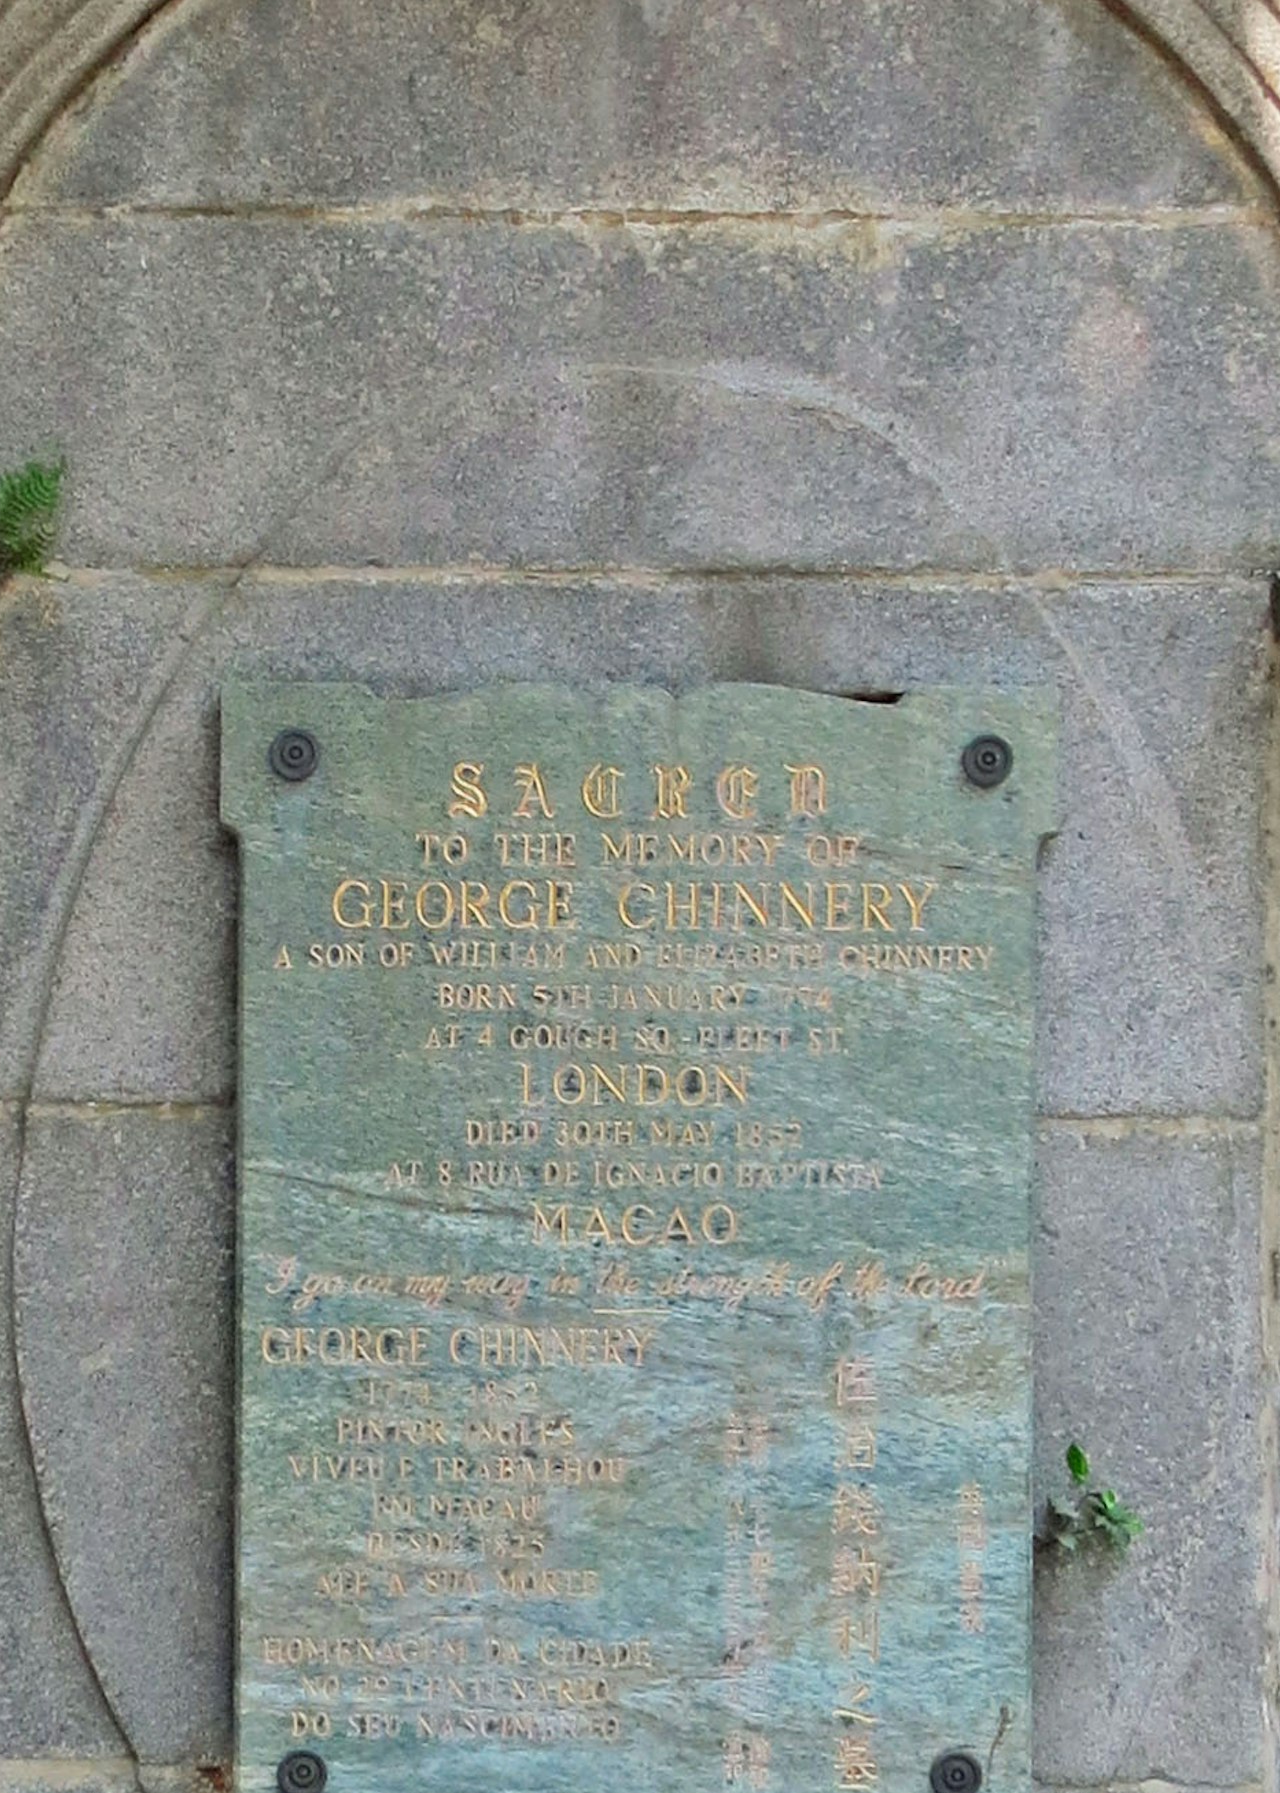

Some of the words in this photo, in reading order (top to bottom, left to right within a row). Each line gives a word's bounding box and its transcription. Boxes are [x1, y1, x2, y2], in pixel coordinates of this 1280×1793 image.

[447, 761, 828, 820] SACRED
[415, 833, 468, 867] TO
[493, 833, 577, 867] THE
[600, 833, 784, 868] MEMORY
[806, 834, 861, 868] OF
[331, 879, 575, 931] GEORGE
[618, 880, 939, 933] CHINNERY
[273, 945, 294, 970] A
[307, 943, 366, 969] SON
[378, 943, 416, 969] OF
[428, 941, 567, 969] WILLIAM
[584, 943, 644, 970] AND
[657, 943, 827, 970] ELIZABETH
[838, 943, 995, 971] CHINNERY
[437, 983, 516, 1010] BORN
[532, 983, 592, 1010] 5TH
[608, 983, 748, 1012] JANUARY
[423, 1024, 463, 1050] AT
[477, 1024, 496, 1050] 4
[509, 1024, 620, 1051] GOUGH
[519, 1062, 751, 1107] LONDON
[465, 1119, 541, 1148] DIED
[554, 1120, 635, 1148] 30TH
[650, 1120, 717, 1148] MAY
[386, 1160, 424, 1188] AT
[437, 1161, 454, 1188] 8
[468, 1160, 524, 1188] RUA
[544, 1160, 581, 1188] DE
[593, 1160, 725, 1188] IGNACIO
[735, 1161, 884, 1191] BAPTISTA
[530, 1201, 740, 1246] MACAO
[293, 1273, 346, 1310] go
[352, 1273, 394, 1294] on
[404, 1273, 452, 1306] my
[462, 1273, 531, 1308] way
[549, 1268, 582, 1295] in
[599, 1261, 639, 1295] the
[797, 1260, 844, 1312] of
[261, 1327, 433, 1366] GEORGE
[448, 1325, 657, 1368] CHINNERY
[336, 1418, 449, 1446] PINTOR
[288, 1455, 386, 1483] VIVEU
[399, 1455, 416, 1483] E
[433, 1456, 629, 1485] TRABALHOU
[429, 1494, 542, 1521] MACAU
[424, 1570, 480, 1596] SUA
[496, 1569, 602, 1597] MORTE
[261, 1637, 468, 1665] HOMENAGEM
[487, 1637, 523, 1664] DA
[539, 1637, 654, 1668] CIDADE
[301, 1675, 342, 1700] NO
[290, 1710, 332, 1738] DO
[348, 1710, 401, 1738] SEU
[414, 1711, 622, 1740] NASCIMENTO
